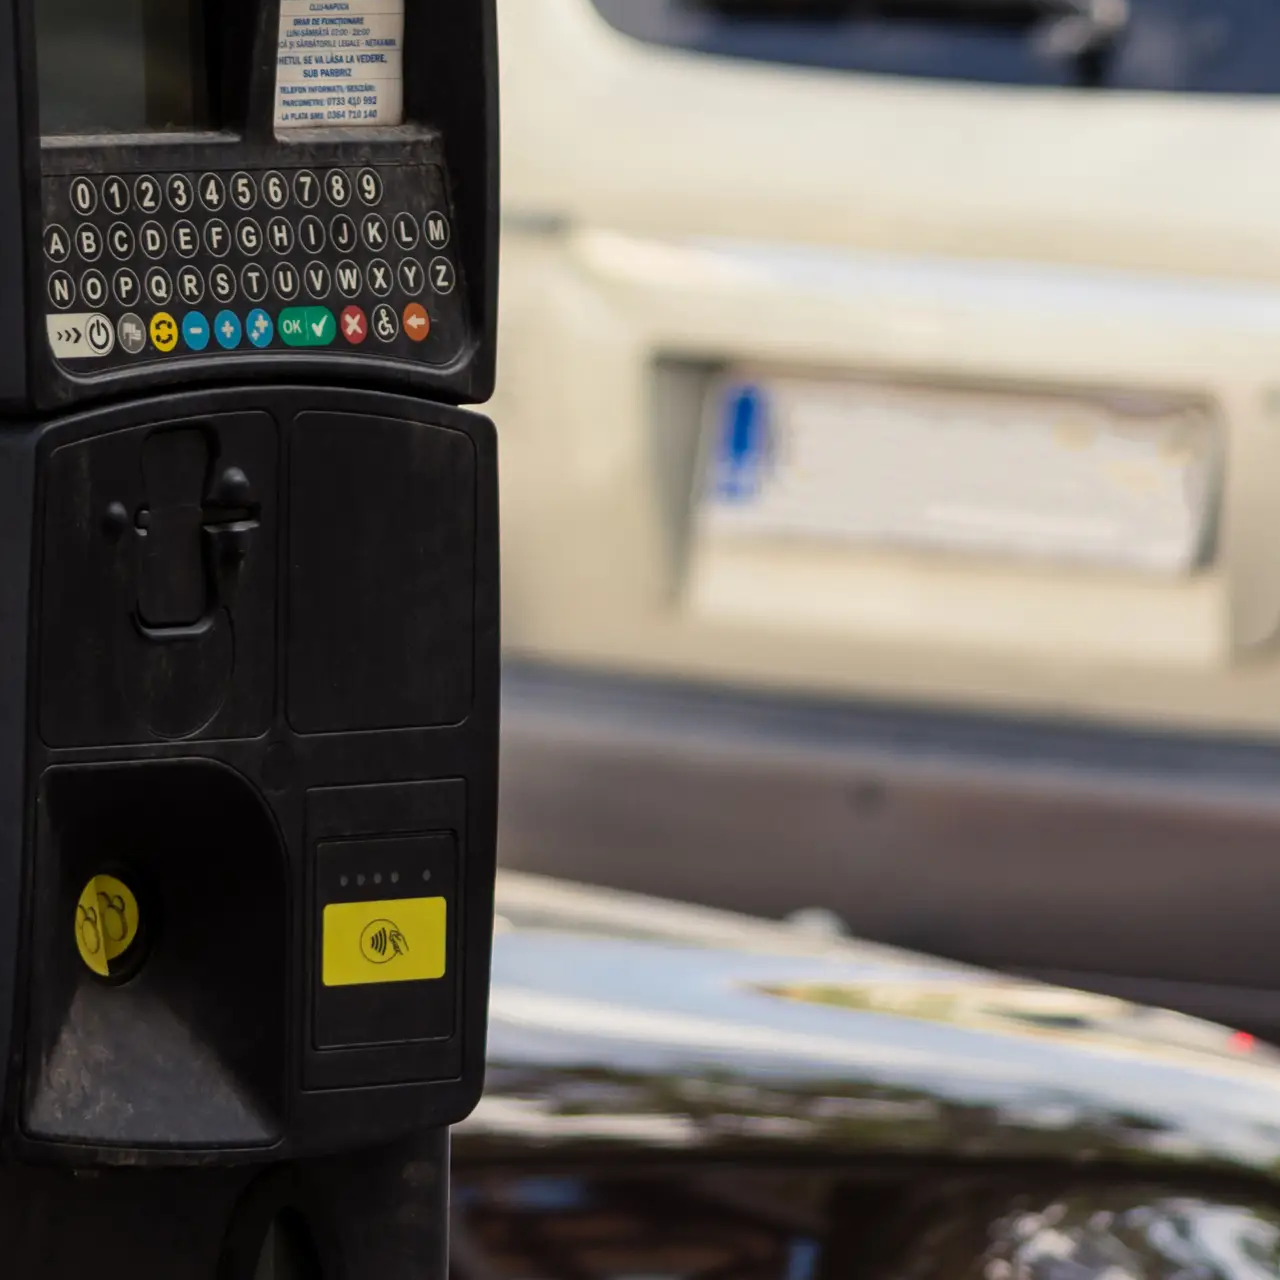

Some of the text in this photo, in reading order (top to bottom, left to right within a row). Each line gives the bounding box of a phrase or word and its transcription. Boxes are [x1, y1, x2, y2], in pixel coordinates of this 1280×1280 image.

[311, 18, 321, 26] DE
[338, 39, 360, 47] LEGALE
[303, 56, 313, 64] SE
[315, 56, 325, 64] VA
[346, 55, 354, 63] LA
[303, 69, 352, 77] SUB PARBRIZ
[280, 86, 307, 94] TELEFON
[327, 97, 345, 106] 0733
[363, 96, 377, 105] 992
[327, 110, 345, 119] 0364
[77, 174, 376, 209] 0 1 2 3 4 5 6 7 8 9
[50, 232, 65, 254] A
[81, 231, 96, 253] B
[114, 230, 128, 252] C
[146, 229, 161, 251] D
[178, 228, 193, 250] E
[211, 227, 223, 249] F
[241, 225, 257, 248] G
[273, 224, 288, 246] H
[338, 222, 348, 244] J
[367, 221, 383, 243] K
[400, 220, 413, 242] L
[428, 219, 445, 241] M
[54, 265, 449, 301] N O P Q R S T U V W X Y Z
[283, 320, 301, 334] OK
